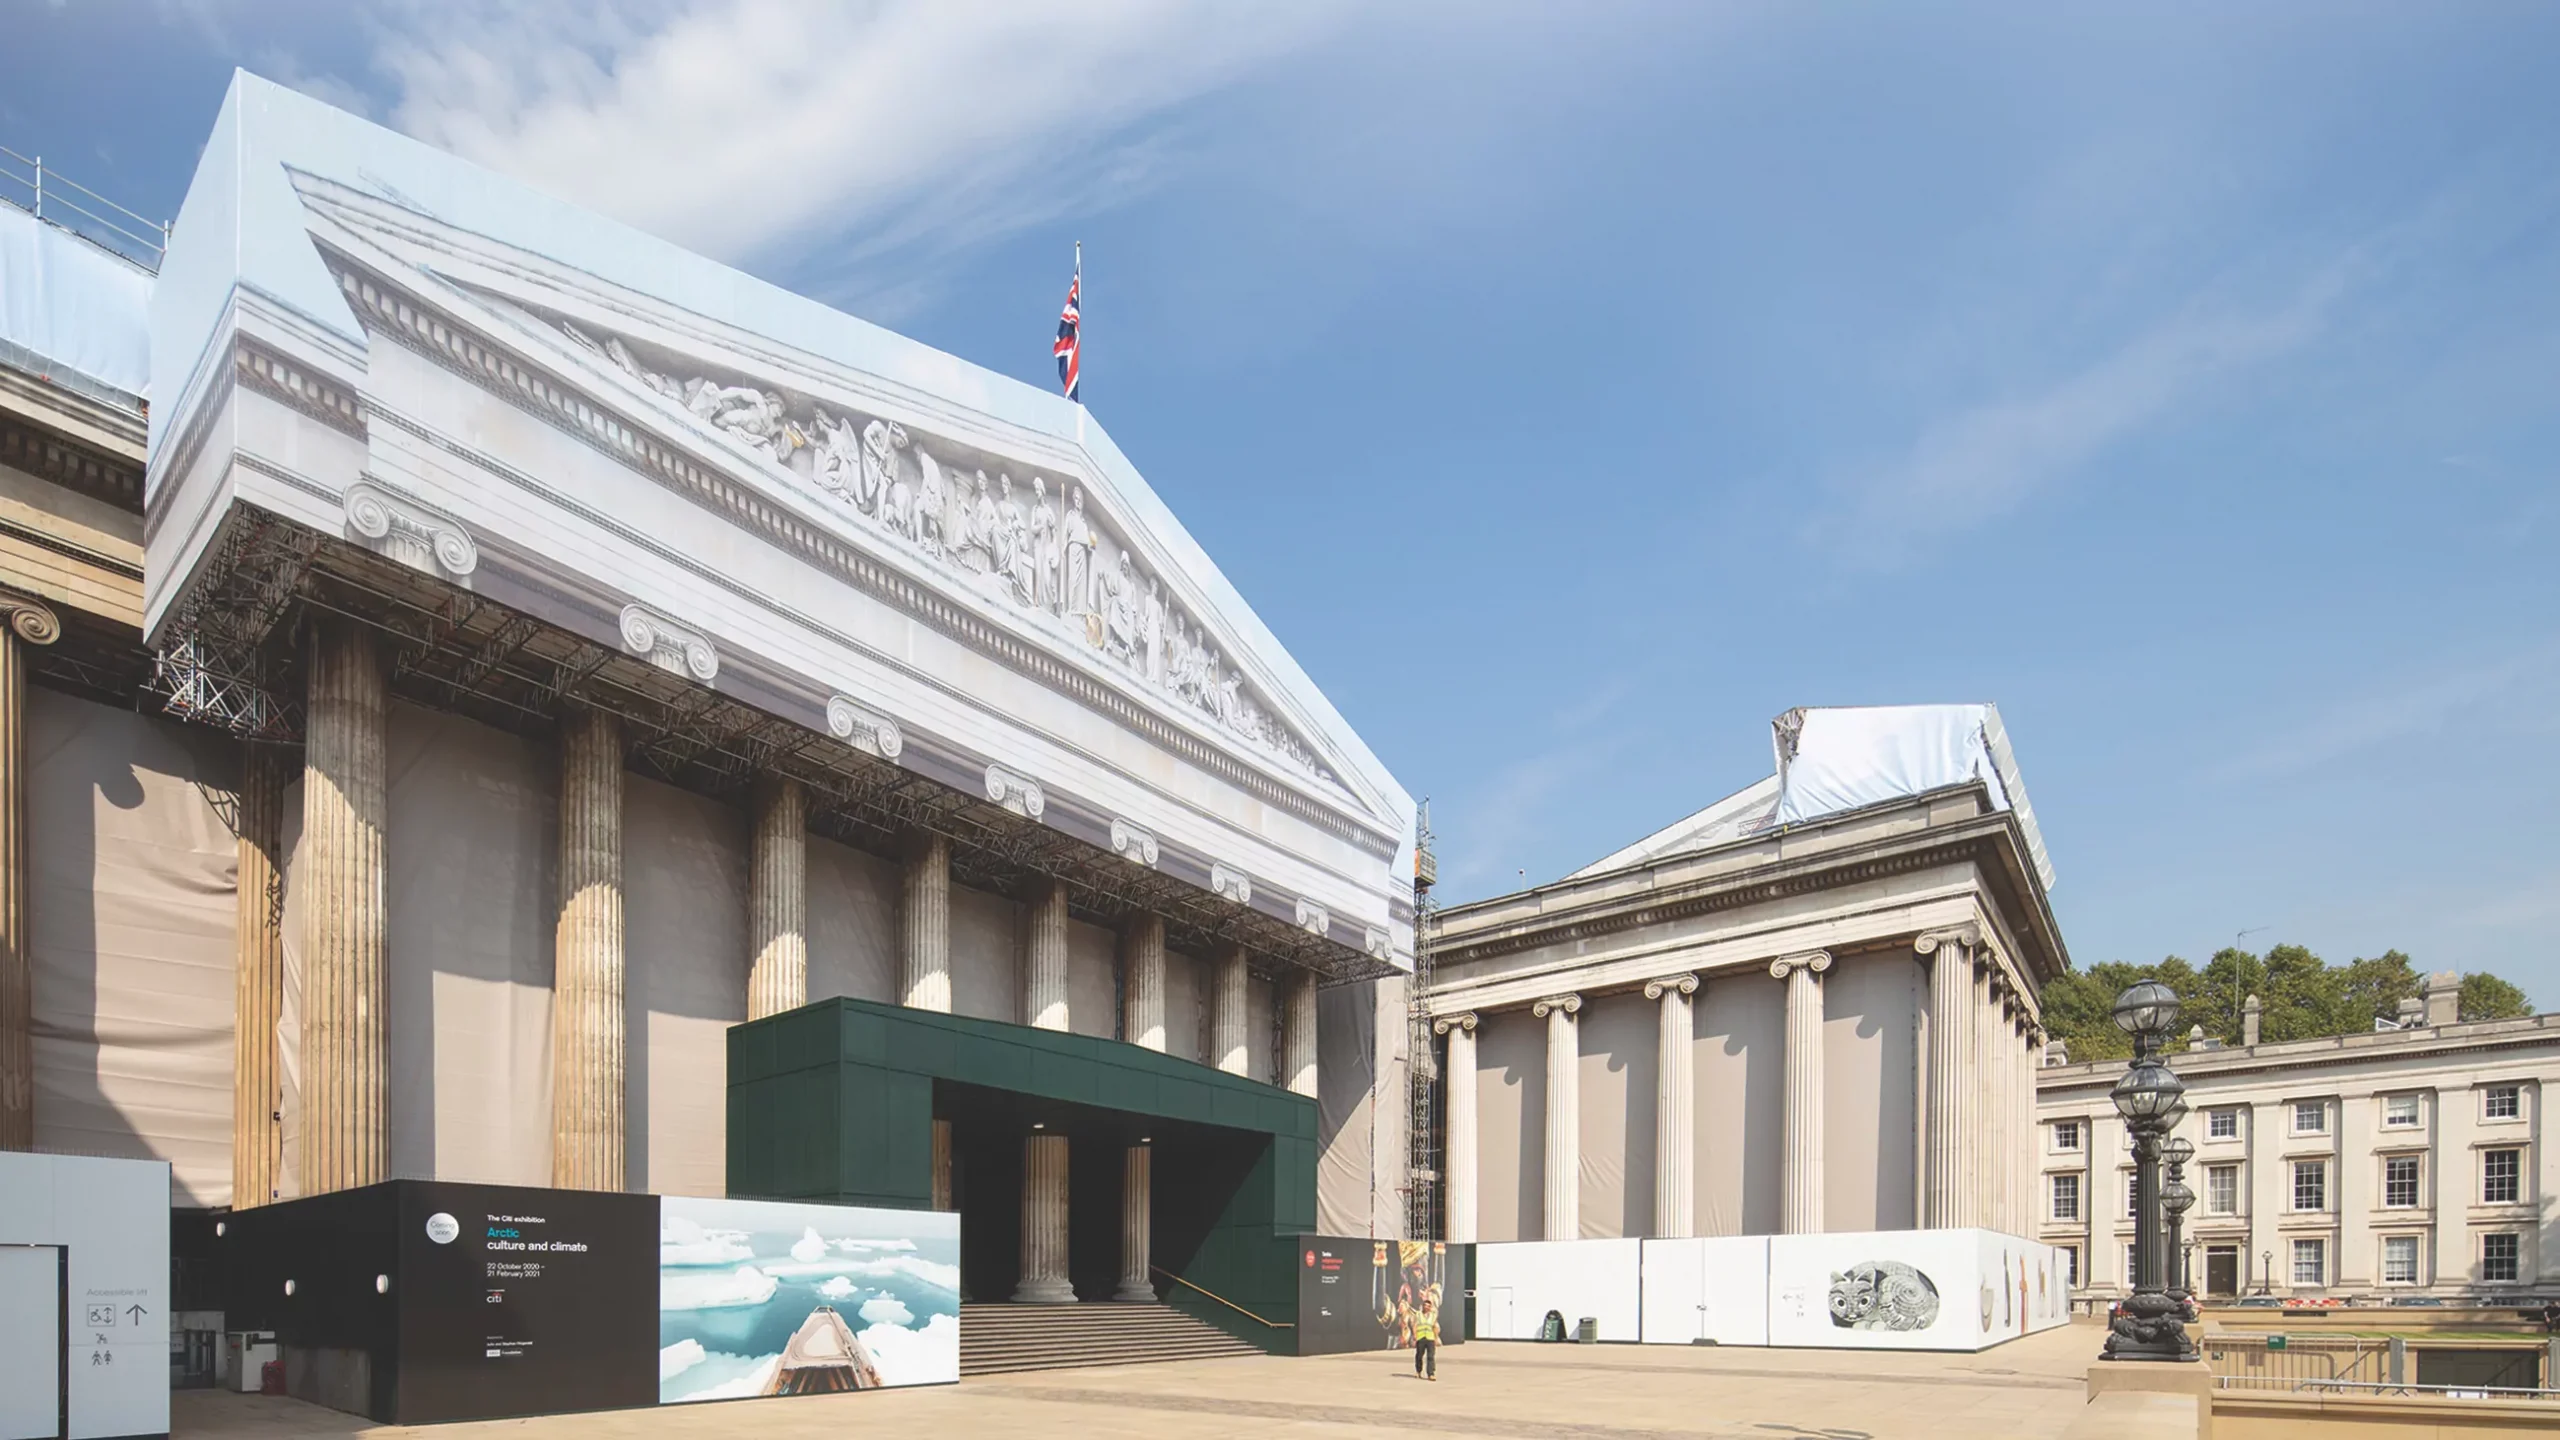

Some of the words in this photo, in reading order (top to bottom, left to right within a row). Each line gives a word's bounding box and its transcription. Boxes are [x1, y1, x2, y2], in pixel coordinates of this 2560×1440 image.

[487, 1214, 500, 1222] The
[514, 1216, 546, 1224] exhibition
[487, 1226, 520, 1238] Arctic
[487, 1240, 526, 1250] culture
[528, 1241, 548, 1251] and
[550, 1241, 588, 1252] climate
[486, 1262, 496, 1270] 22
[497, 1262, 522, 1270] October
[522, 1262, 540, 1270] 2020
[496, 1270, 524, 1279] February
[86, 1288, 135, 1297] Accessible
[486, 1295, 502, 1303] citi
